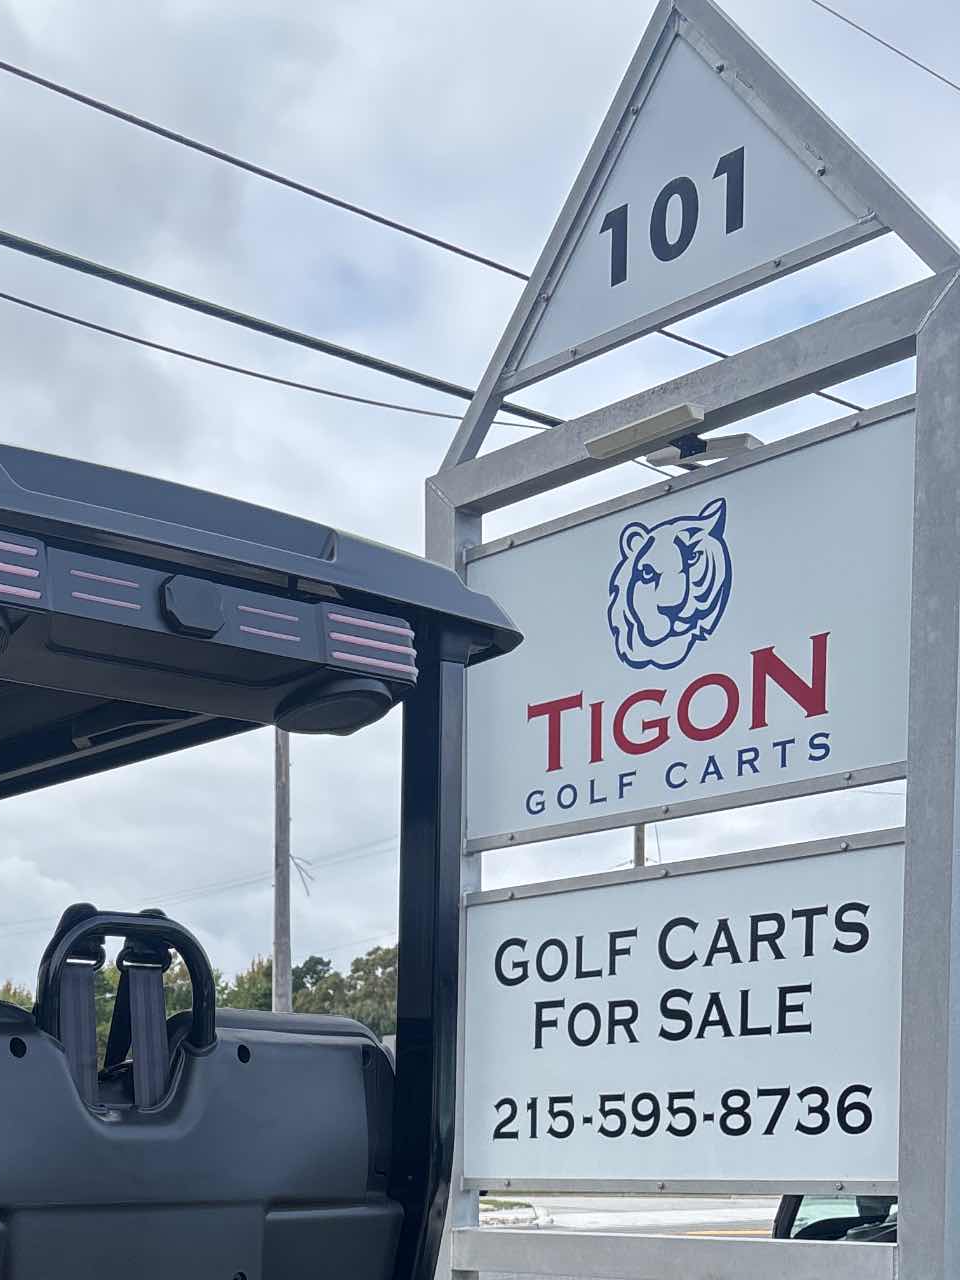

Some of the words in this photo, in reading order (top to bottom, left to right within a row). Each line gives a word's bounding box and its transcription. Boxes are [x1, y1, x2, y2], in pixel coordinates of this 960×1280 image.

[599, 146, 744, 287] 101
[527, 632, 830, 771] TIGON
[526, 770, 637, 816] GOLF
[665, 732, 831, 789] CARTS
[494, 928, 638, 987] GOLF
[657, 902, 870, 970] CARTS
[533, 998, 640, 1050] FOR
[658, 982, 813, 1042] SALE
[492, 1084, 873, 1140] 215-595-8736
